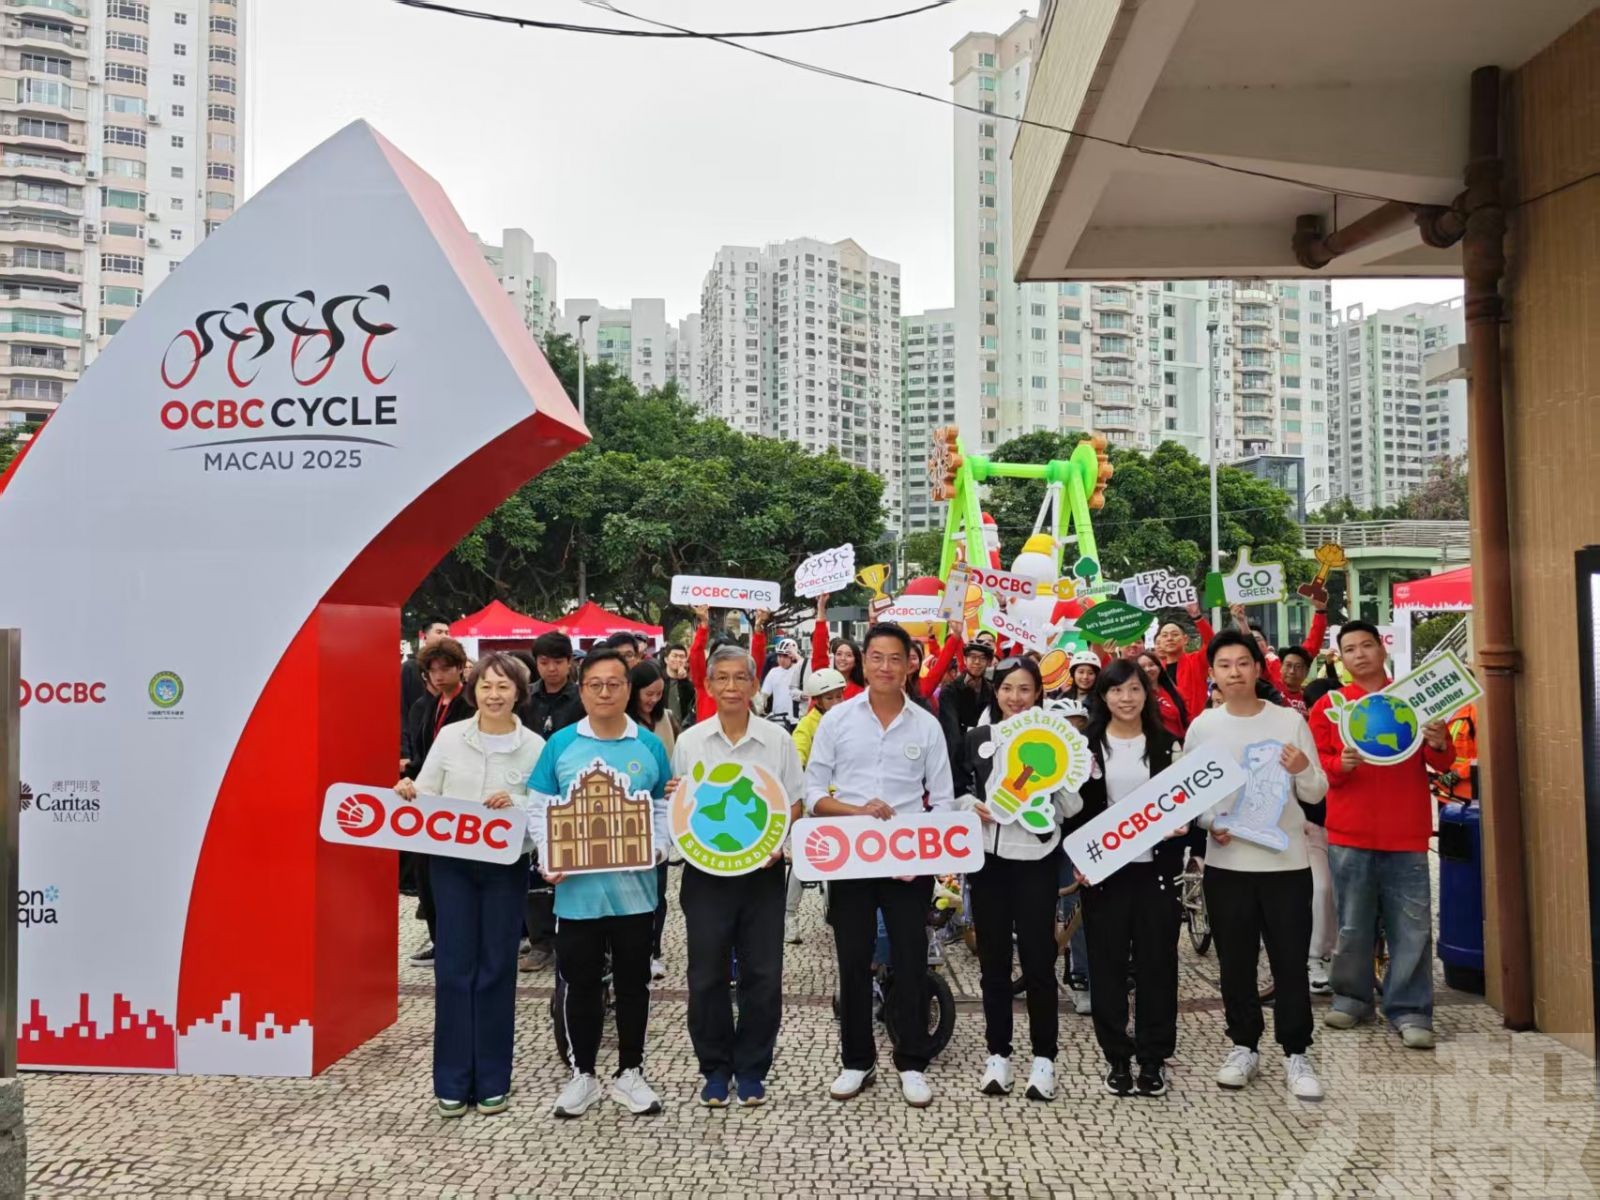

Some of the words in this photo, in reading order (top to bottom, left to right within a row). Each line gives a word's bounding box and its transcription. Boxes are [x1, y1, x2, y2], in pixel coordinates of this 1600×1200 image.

[160, 398, 265, 430] OCBC
[271, 395, 397, 428] CYCLE
[204, 451, 294, 471] MACAU
[302, 450, 362, 469] 2025
[821, 570, 850, 583] CYCLE
[985, 574, 1032, 595] OCBC
[1136, 571, 1166, 586] LET'S
[1166, 577, 1187, 590] GO
[1237, 569, 1272, 588] GO
[1144, 588, 1195, 609] CYCLE
[1238, 587, 1274, 598] GREEN
[1006, 622, 1037, 644] OCBC
[1414, 670, 1437, 687] Let's
[35, 682, 106, 703] OCBC
[1408, 691, 1426, 708] GO
[1425, 671, 1461, 696] GREEN
[1422, 687, 1464, 717] Together
[1001, 711, 1086, 786] Sustainability
[36, 793, 100, 811] Caritas
[53, 812, 100, 822] MACAU
[390, 806, 513, 850] OCBC
[683, 820, 785, 868] Sustainability
[855, 825, 971, 863] OCBC
[18, 890, 44, 905] on
[18, 907, 58, 928] qua
